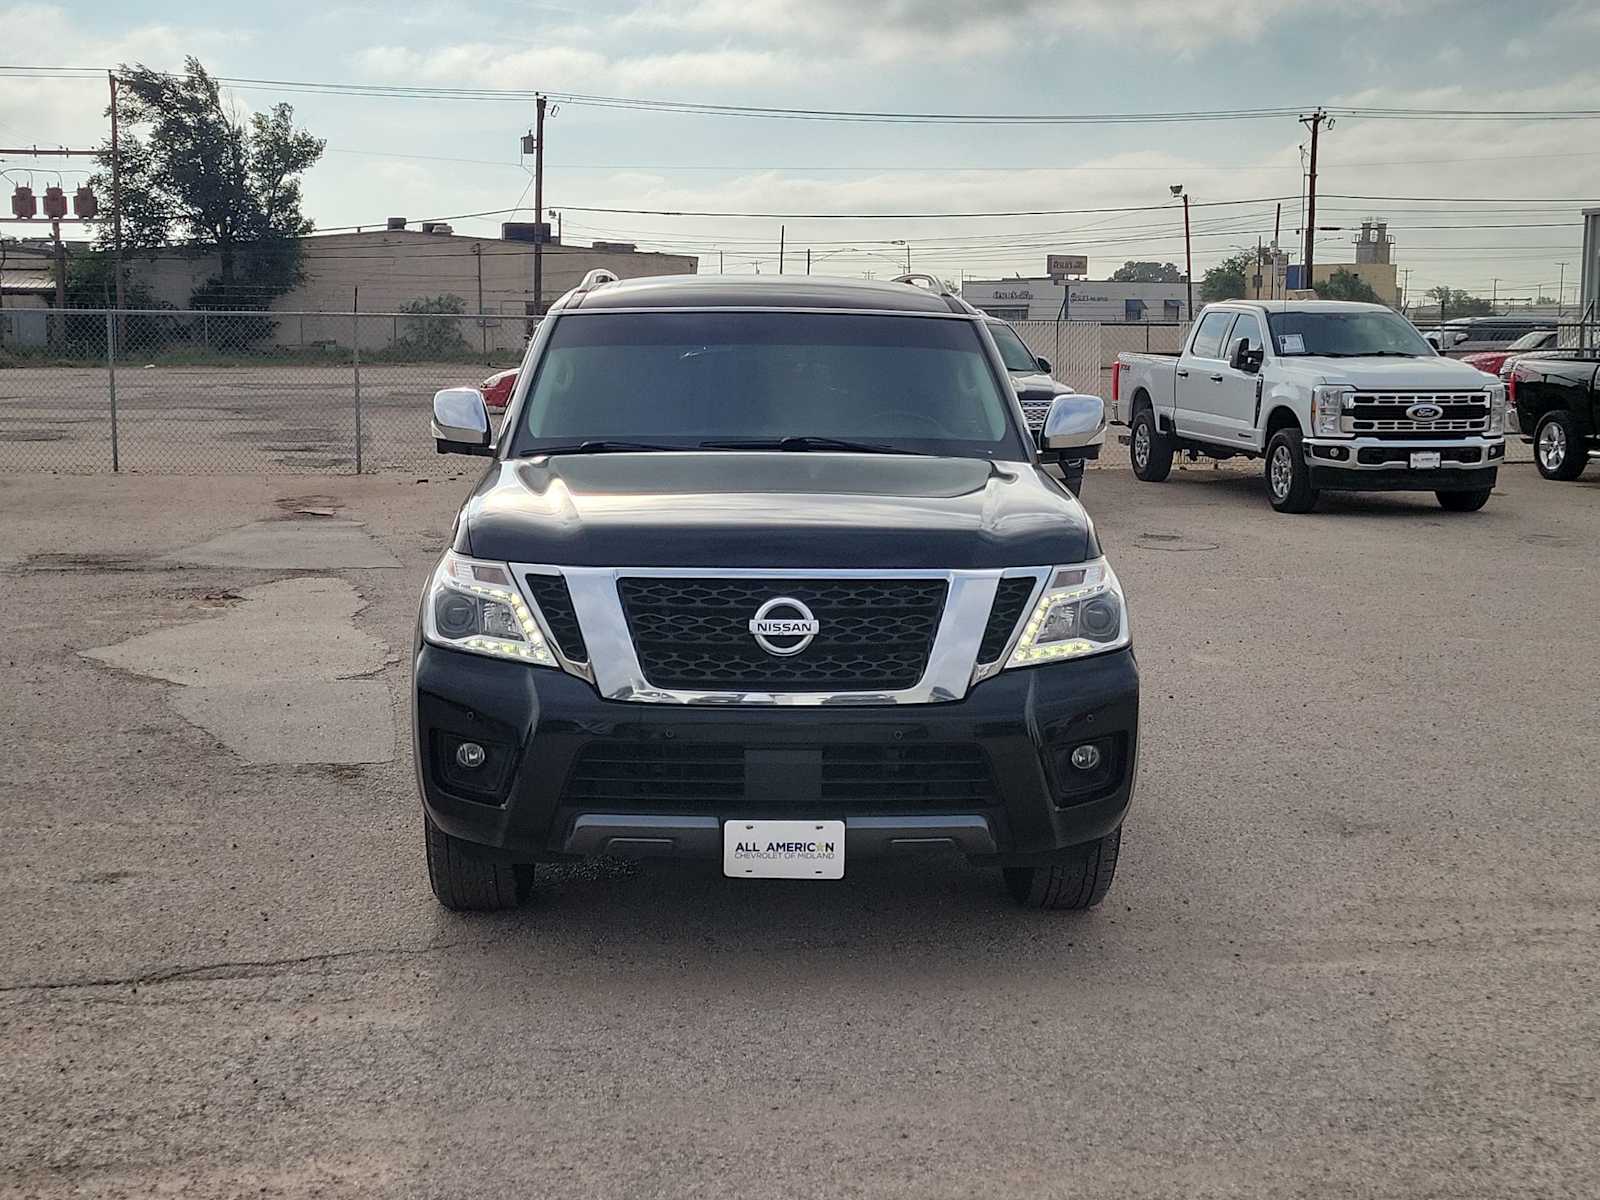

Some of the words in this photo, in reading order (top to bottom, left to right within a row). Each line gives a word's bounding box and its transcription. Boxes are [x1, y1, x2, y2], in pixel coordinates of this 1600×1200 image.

[1416, 408, 1435, 417] Ford
[757, 623, 812, 632] NISSAN
[735, 842, 760, 852] ALL
[734, 852, 782, 860] CHEVROLET
[784, 852, 795, 860] OF
[797, 852, 835, 860] MIDLAND
